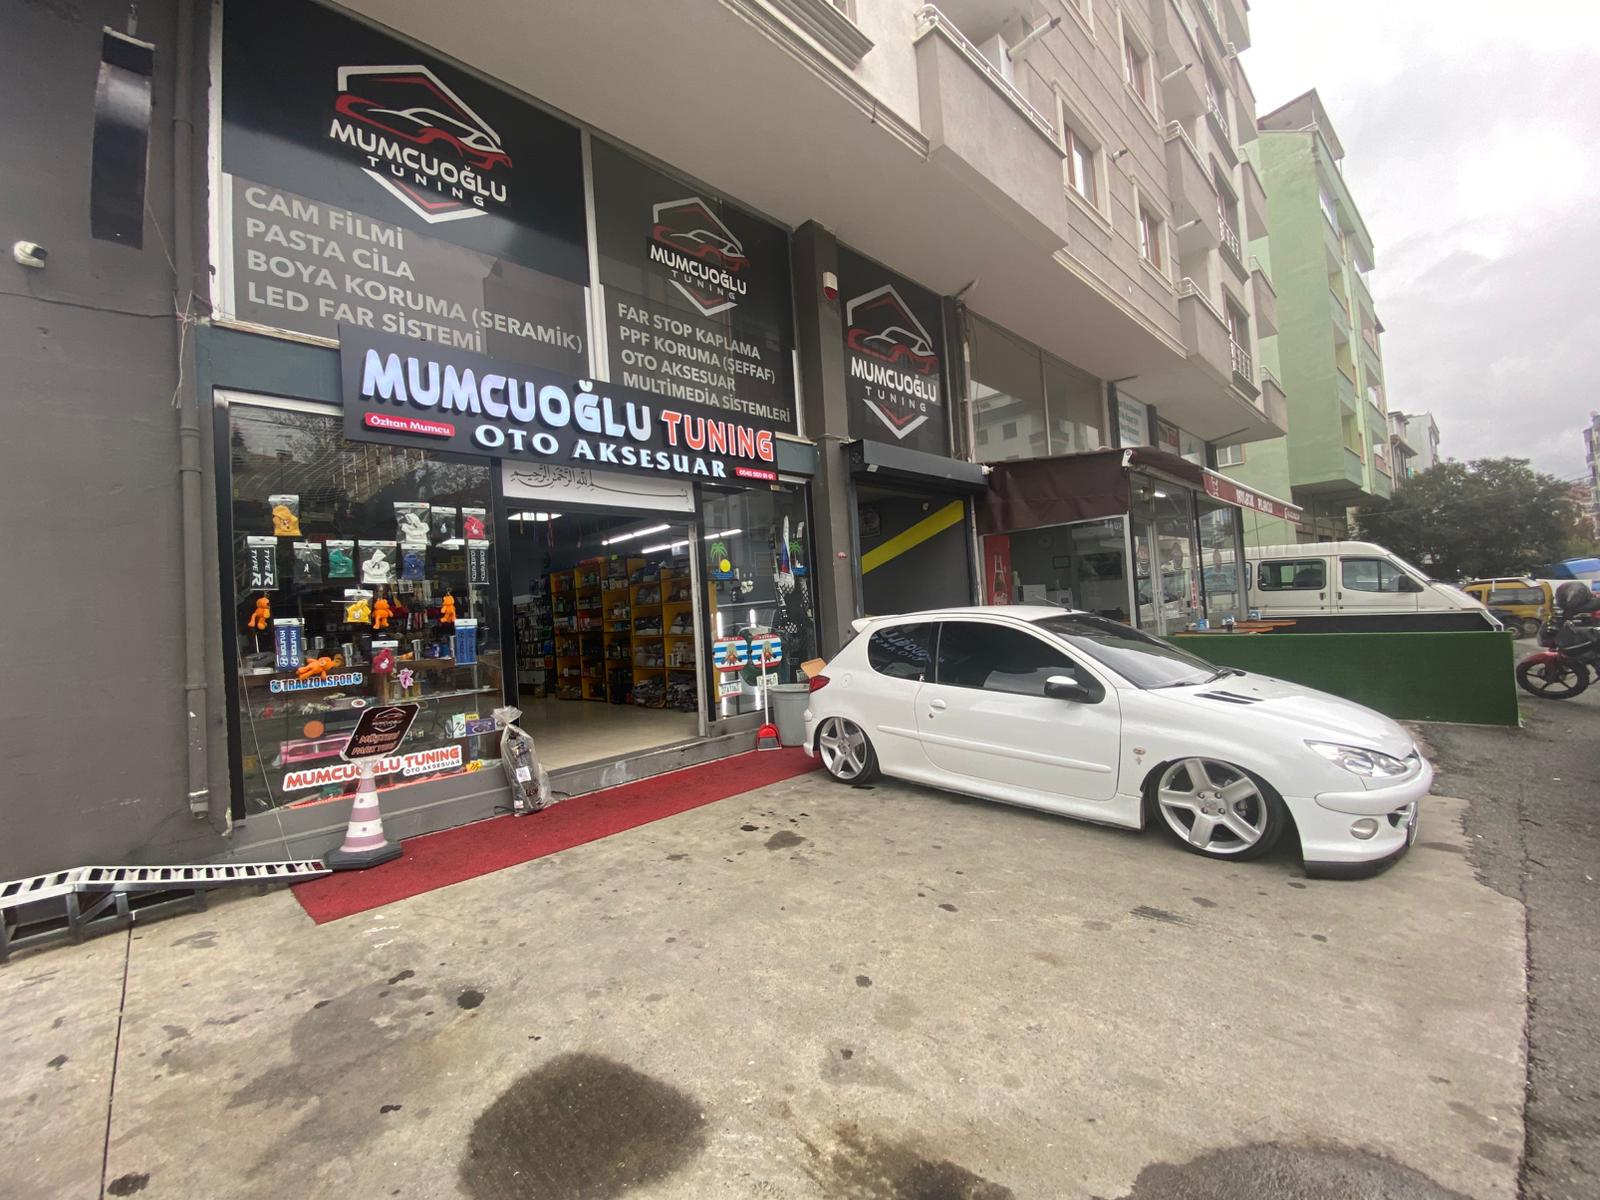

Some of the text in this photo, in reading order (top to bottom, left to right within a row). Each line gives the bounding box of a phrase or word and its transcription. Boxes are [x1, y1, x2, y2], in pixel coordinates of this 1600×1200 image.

[329, 119, 507, 202] MUMCUOĞLU
[367, 156, 484, 206] TUNING
[245, 187, 403, 250] CAM FİLMİ
[246, 217, 415, 281] PASTA CİLA
[650, 244, 747, 295] MUMCUOĞLU
[247, 249, 583, 354] BOYA KORUMA (SERAMİK)
[671, 269, 736, 300] TUNING
[248, 282, 481, 352] LED FAR SİSTEMİ
[617, 303, 761, 360] FAR STOP KAPLAMA
[620, 326, 775, 384] PPF KORUMA (ŞEFFAF)
[621, 349, 736, 391] OTO AKSESUAR
[851, 356, 937, 402] MUMCUOĞLU
[362, 349, 774, 462] MUMCUOĞLU TUNING
[623, 372, 791, 422] MULTİMEDİA SİSTEMLERİ
[865, 385, 926, 412] TUNING
[410, 421, 450, 433] Mumcu
[475, 424, 726, 478] OTO AKSESUAR
[252, 572, 261, 586] R
[264, 572, 273, 586] R
[281, 674, 353, 691] TRABZONSPOR
[405, 747, 459, 768] TUNING
[422, 760, 460, 771] AKSESUAR
